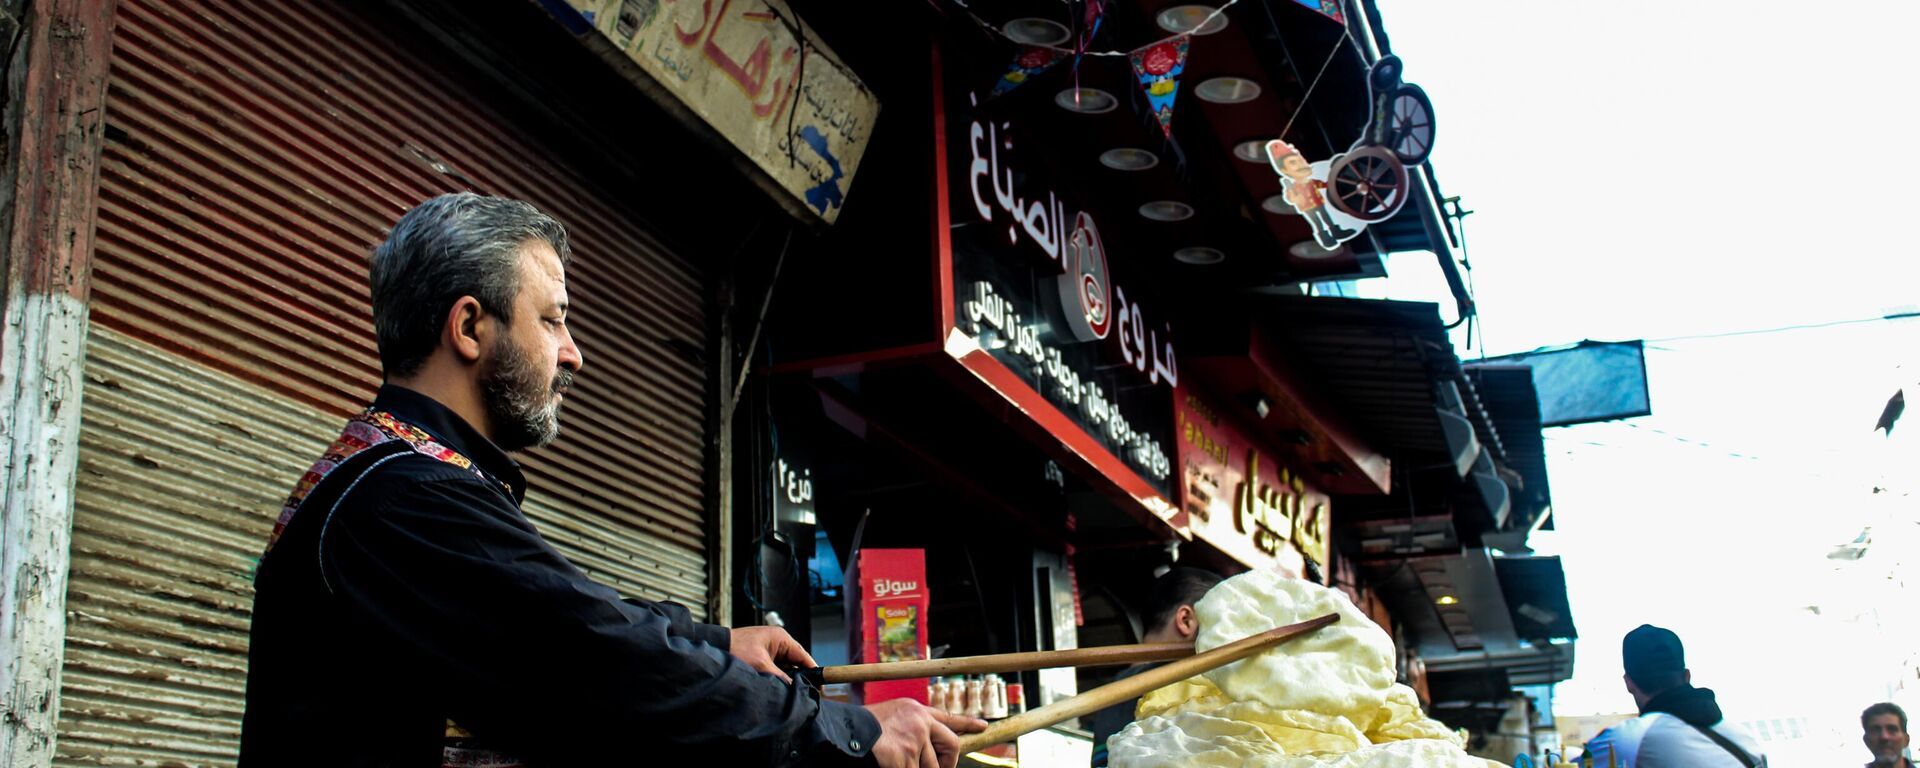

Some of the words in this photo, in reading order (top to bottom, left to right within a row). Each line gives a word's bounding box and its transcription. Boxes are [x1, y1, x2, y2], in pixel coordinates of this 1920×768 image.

[1006, 301, 1044, 377] جاهزة
[1116, 286, 1178, 389] فروج
[1046, 347, 1080, 405] وجبات
[787, 468, 813, 504] فرع
